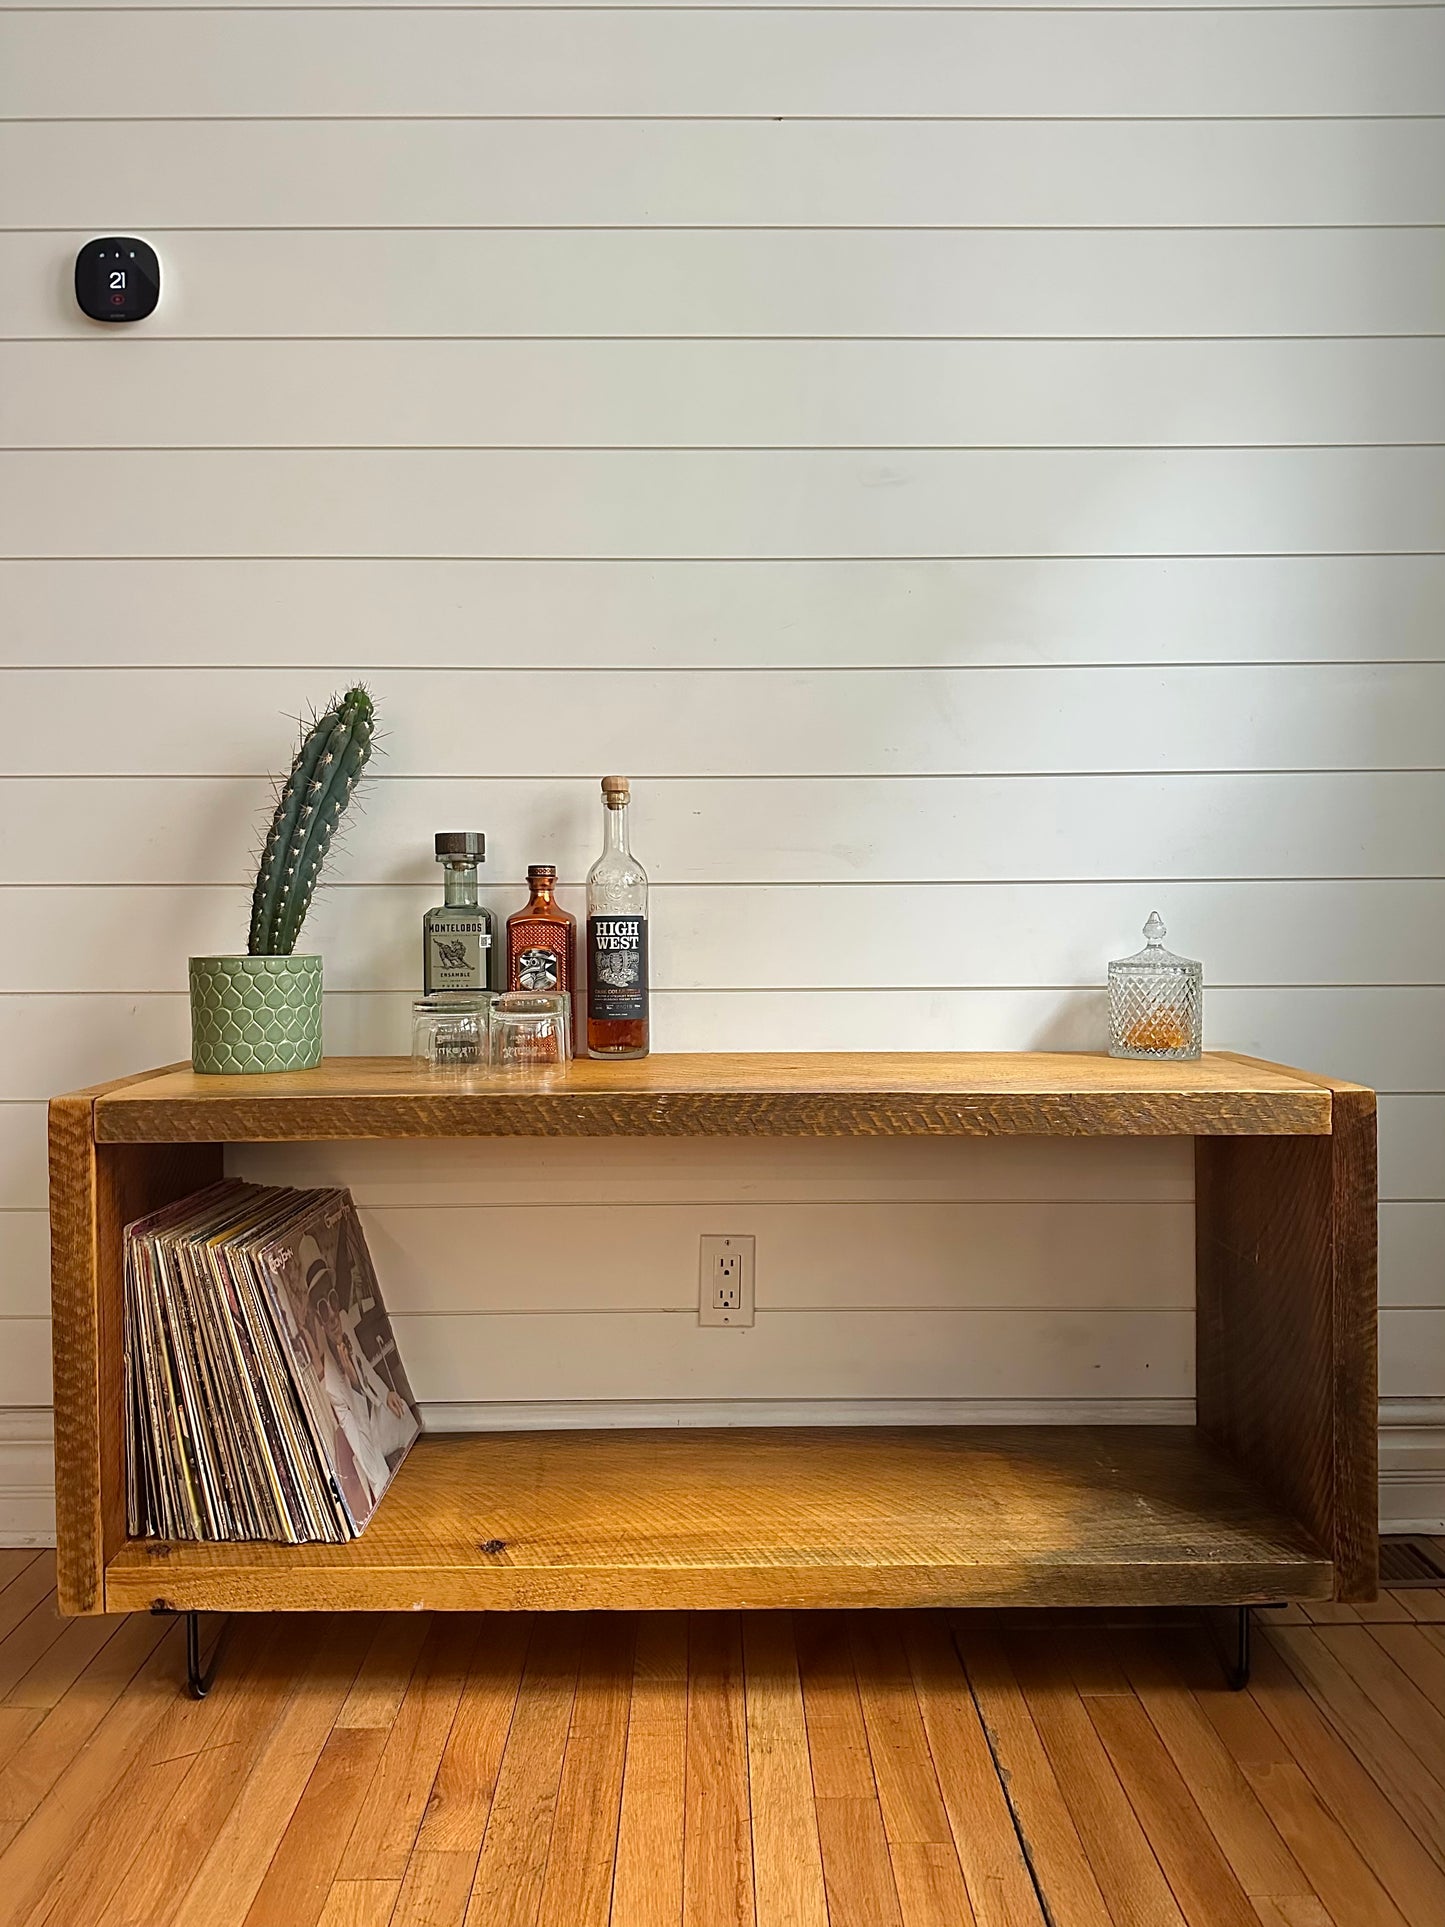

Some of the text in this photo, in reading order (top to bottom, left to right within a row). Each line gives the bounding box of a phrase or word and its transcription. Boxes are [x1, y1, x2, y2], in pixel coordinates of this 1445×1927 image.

[109, 271, 126, 289] 21
[429, 923, 482, 933] MONTELOBOS
[595, 921, 639, 936] HIGH
[596, 936, 639, 950] WEST
